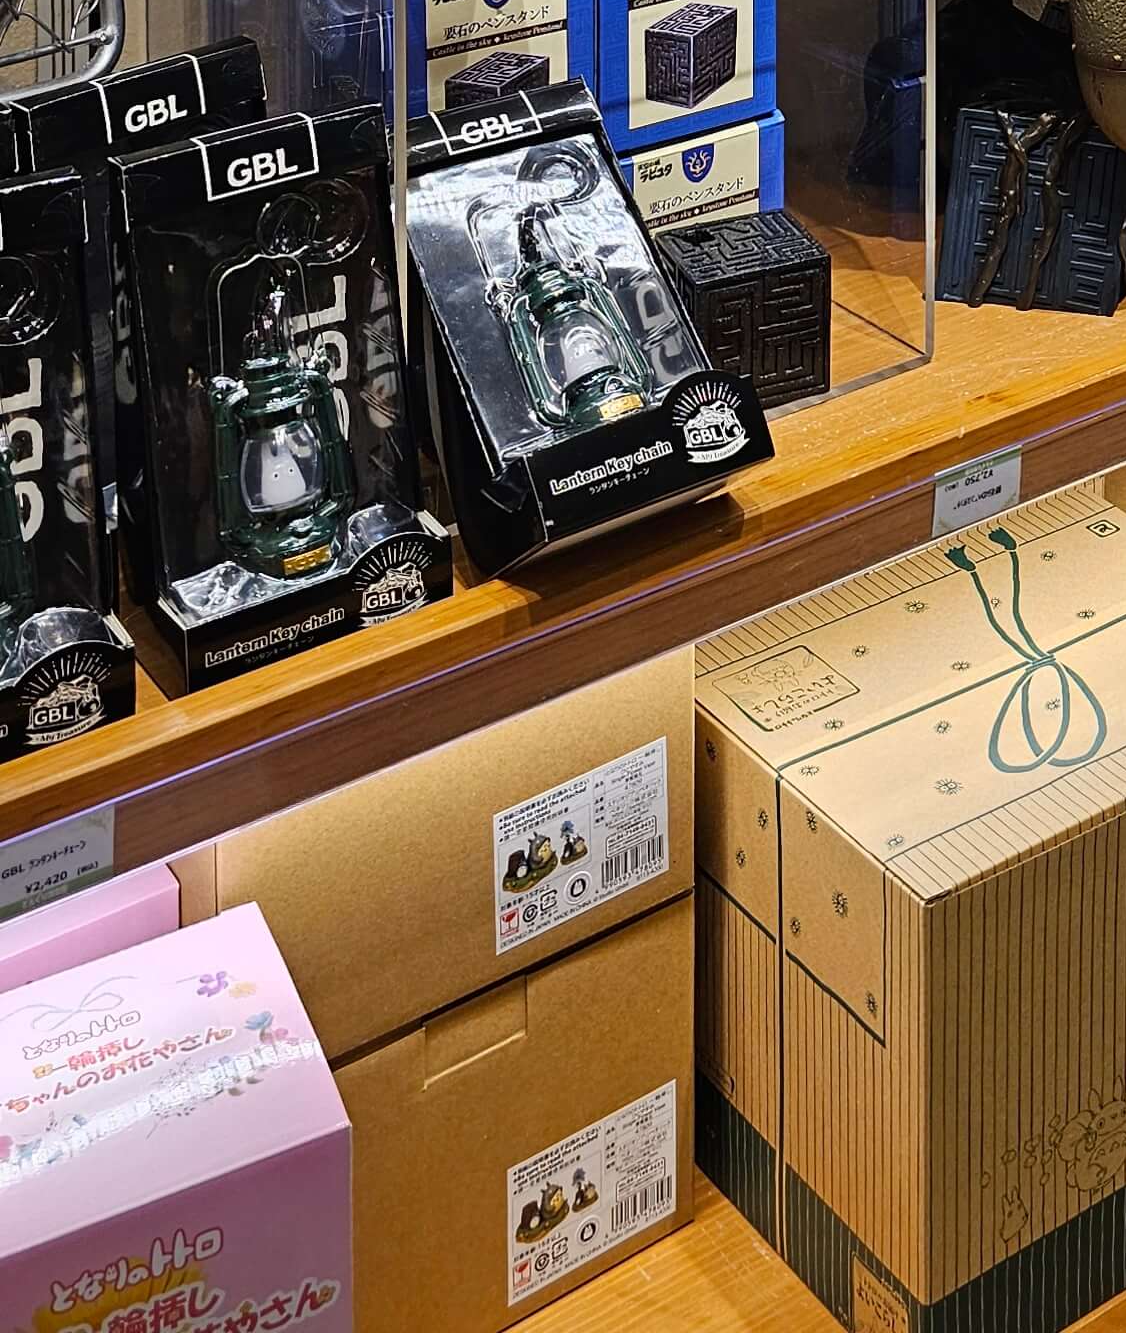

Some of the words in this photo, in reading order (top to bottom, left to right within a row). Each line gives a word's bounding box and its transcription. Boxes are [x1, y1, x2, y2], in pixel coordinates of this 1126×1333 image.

[124, 94, 187, 132] GBL
[460, 111, 524, 145] GBL
[226, 148, 298, 188] GBL
[640, 164, 673, 183] ラピュタ
[690, 425, 723, 445] GBL
[551, 461, 607, 495] Lantern
[608, 454, 634, 476] Key
[634, 441, 674, 464] chain
[588, 467, 650, 495] ランタンキーチェーン
[366, 592, 402, 609] GBL
[205, 634, 269, 668] Lantern
[269, 624, 300, 645] Key
[301, 606, 345, 633] chain
[34, 706, 74, 726] GBL
[1, 863, 25, 880] GBL
[25, 870, 68, 894] ¥2,420
[23, 1010, 142, 1061] となりのトトロ
[51, 1228, 224, 1314] となりのトトロ
